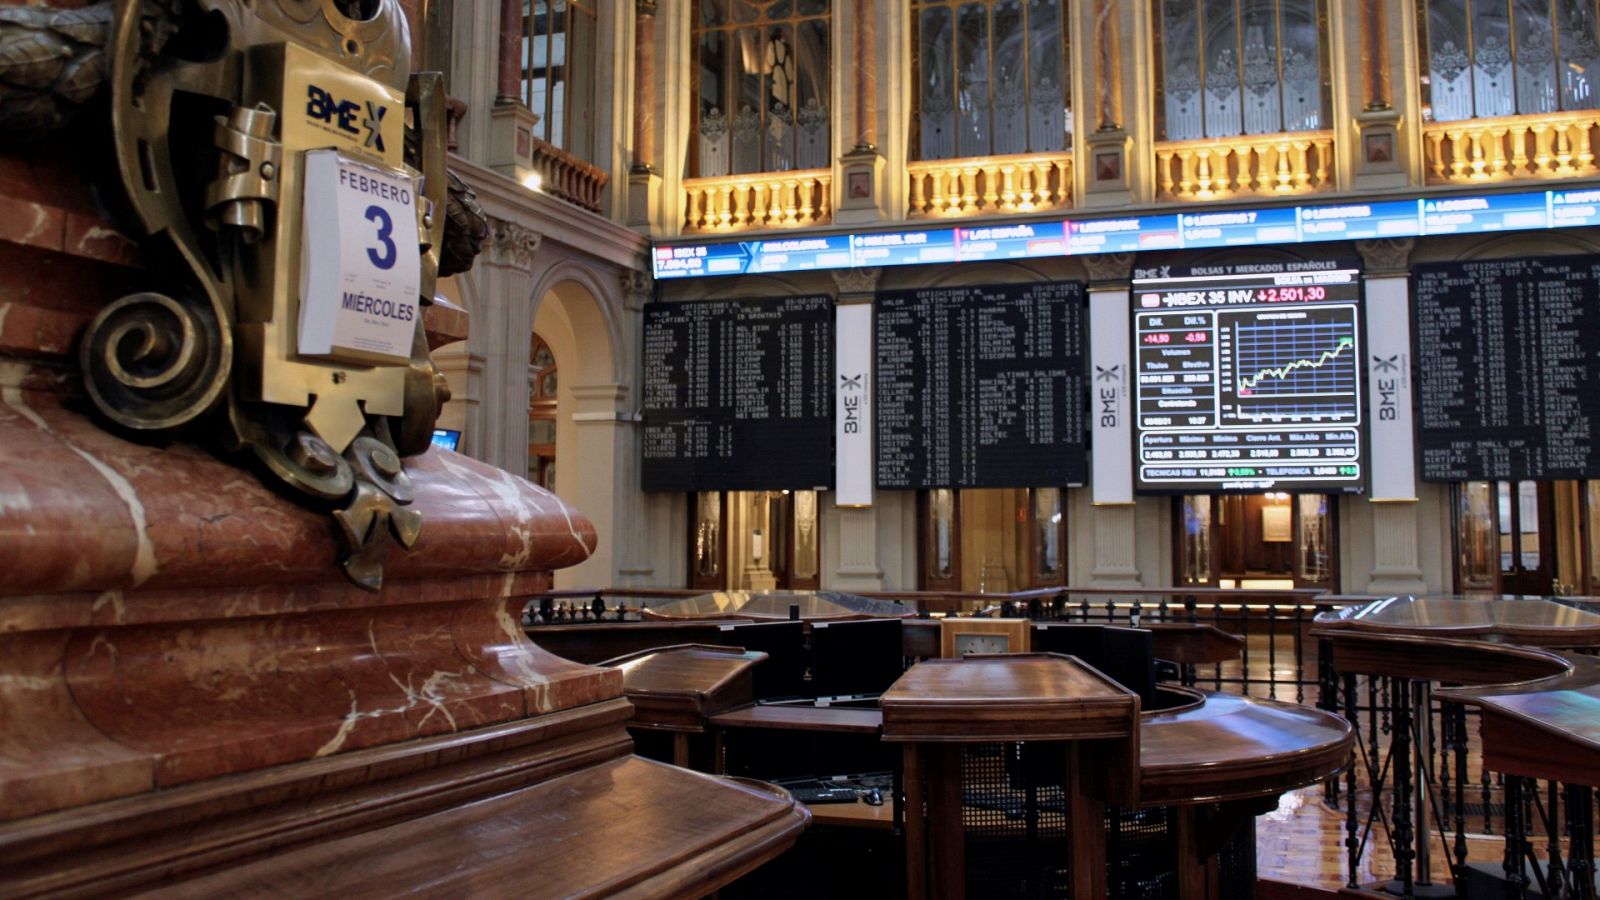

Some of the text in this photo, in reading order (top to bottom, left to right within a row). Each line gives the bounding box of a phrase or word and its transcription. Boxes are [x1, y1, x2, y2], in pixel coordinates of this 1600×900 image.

[306, 85, 361, 134] BME
[340, 169, 410, 205] FEBRERO
[364, 205, 397, 270] 3
[1190, 266, 1224, 276] BOLSAS
[1235, 264, 1284, 274] MERCADOS
[1287, 260, 1337, 271] ESPAÑOLES
[342, 291, 413, 322] MIÉRCOLES
[1208, 291, 1226, 305] 35
[1267, 286, 1325, 303] 2.501,30
[844, 396, 858, 434] BME
[1100, 387, 1116, 428] BME
[1378, 378, 1396, 421] BME
